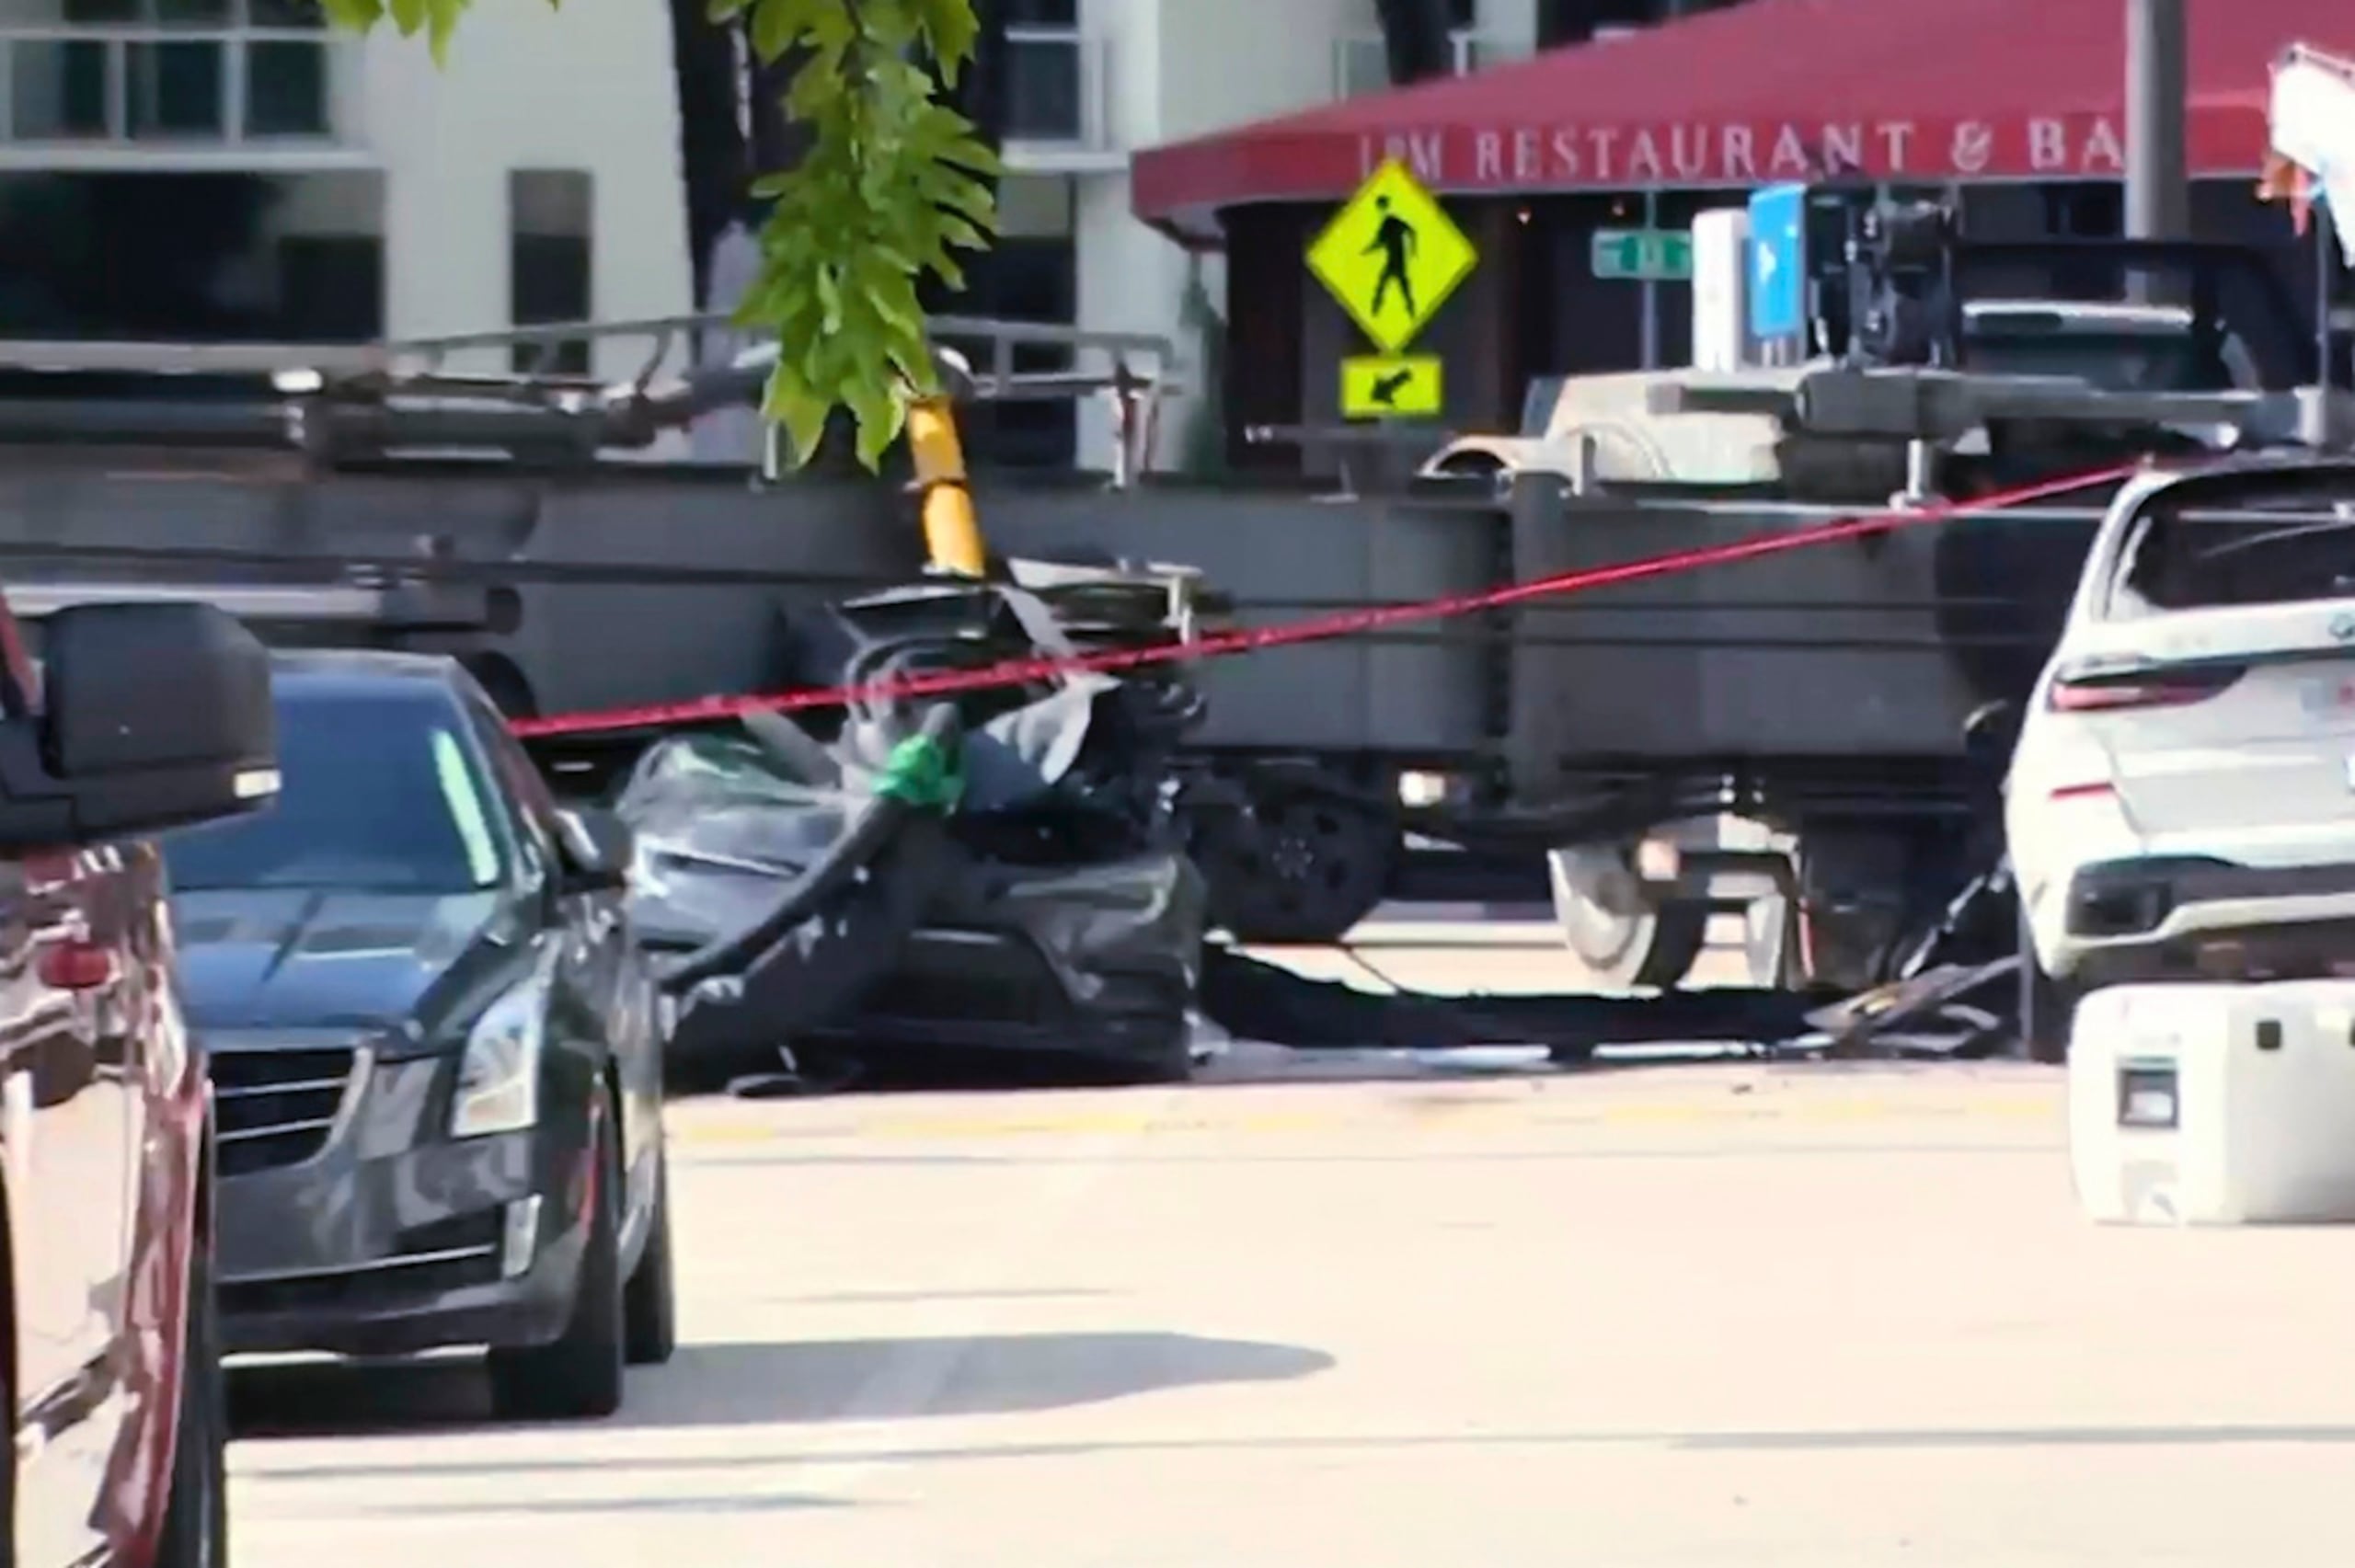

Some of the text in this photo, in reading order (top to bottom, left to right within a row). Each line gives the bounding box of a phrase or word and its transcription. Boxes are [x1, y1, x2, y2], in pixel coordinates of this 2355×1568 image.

[1475, 120, 1915, 181] RESTAURANT
[1950, 119, 1993, 173] &
[2027, 116, 2127, 172] BA
